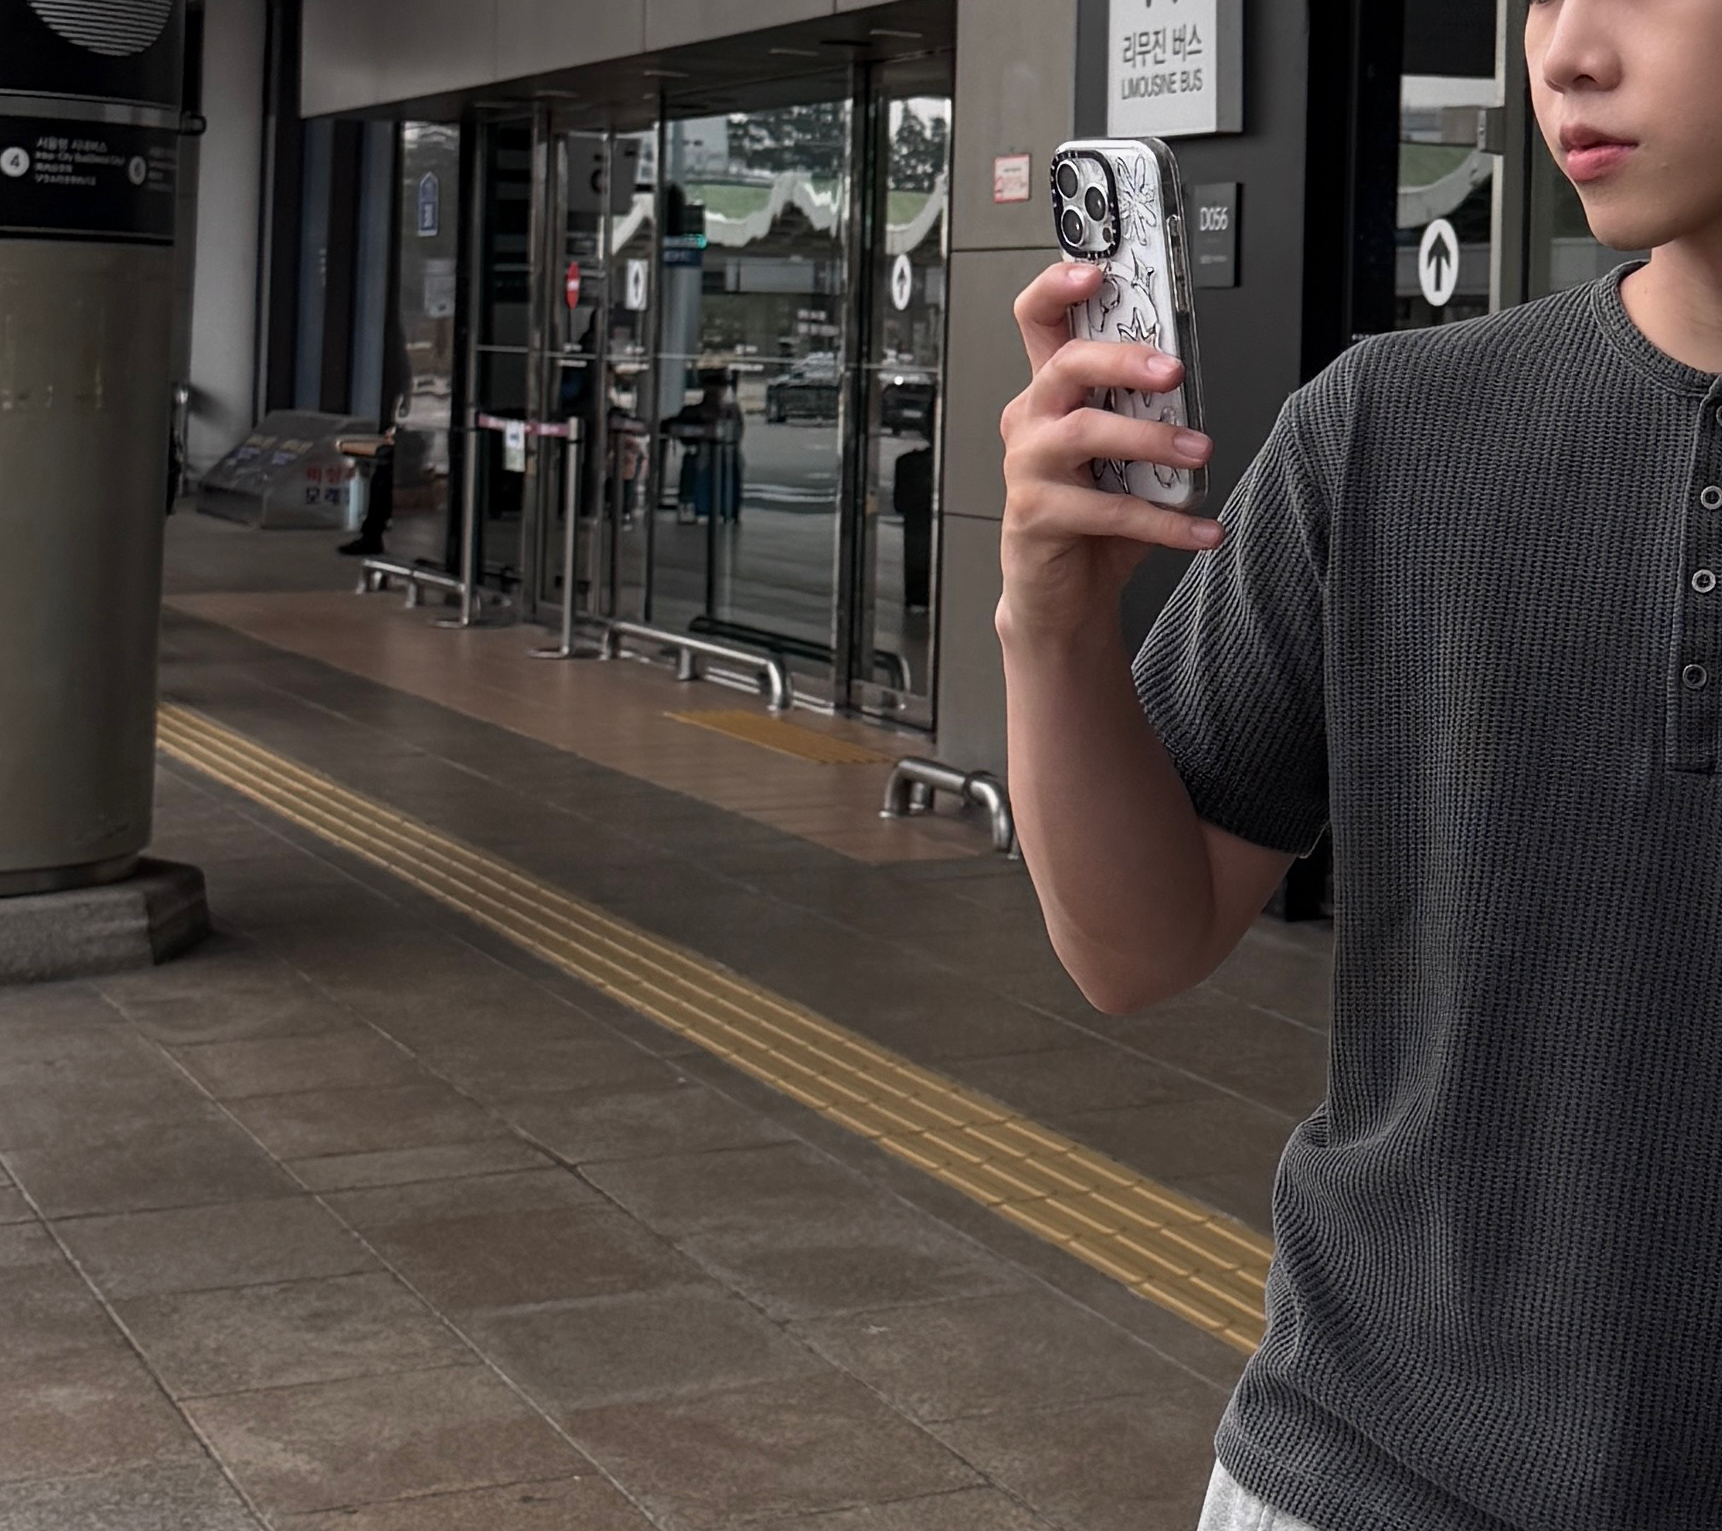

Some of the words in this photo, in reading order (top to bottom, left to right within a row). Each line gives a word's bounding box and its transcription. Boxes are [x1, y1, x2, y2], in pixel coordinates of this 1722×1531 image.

[1123, 27, 1167, 68] 리무진
[1173, 24, 1203, 62] 버스
[1121, 72, 1177, 100] LIMOUSINE
[1181, 68, 1203, 92] BUS
